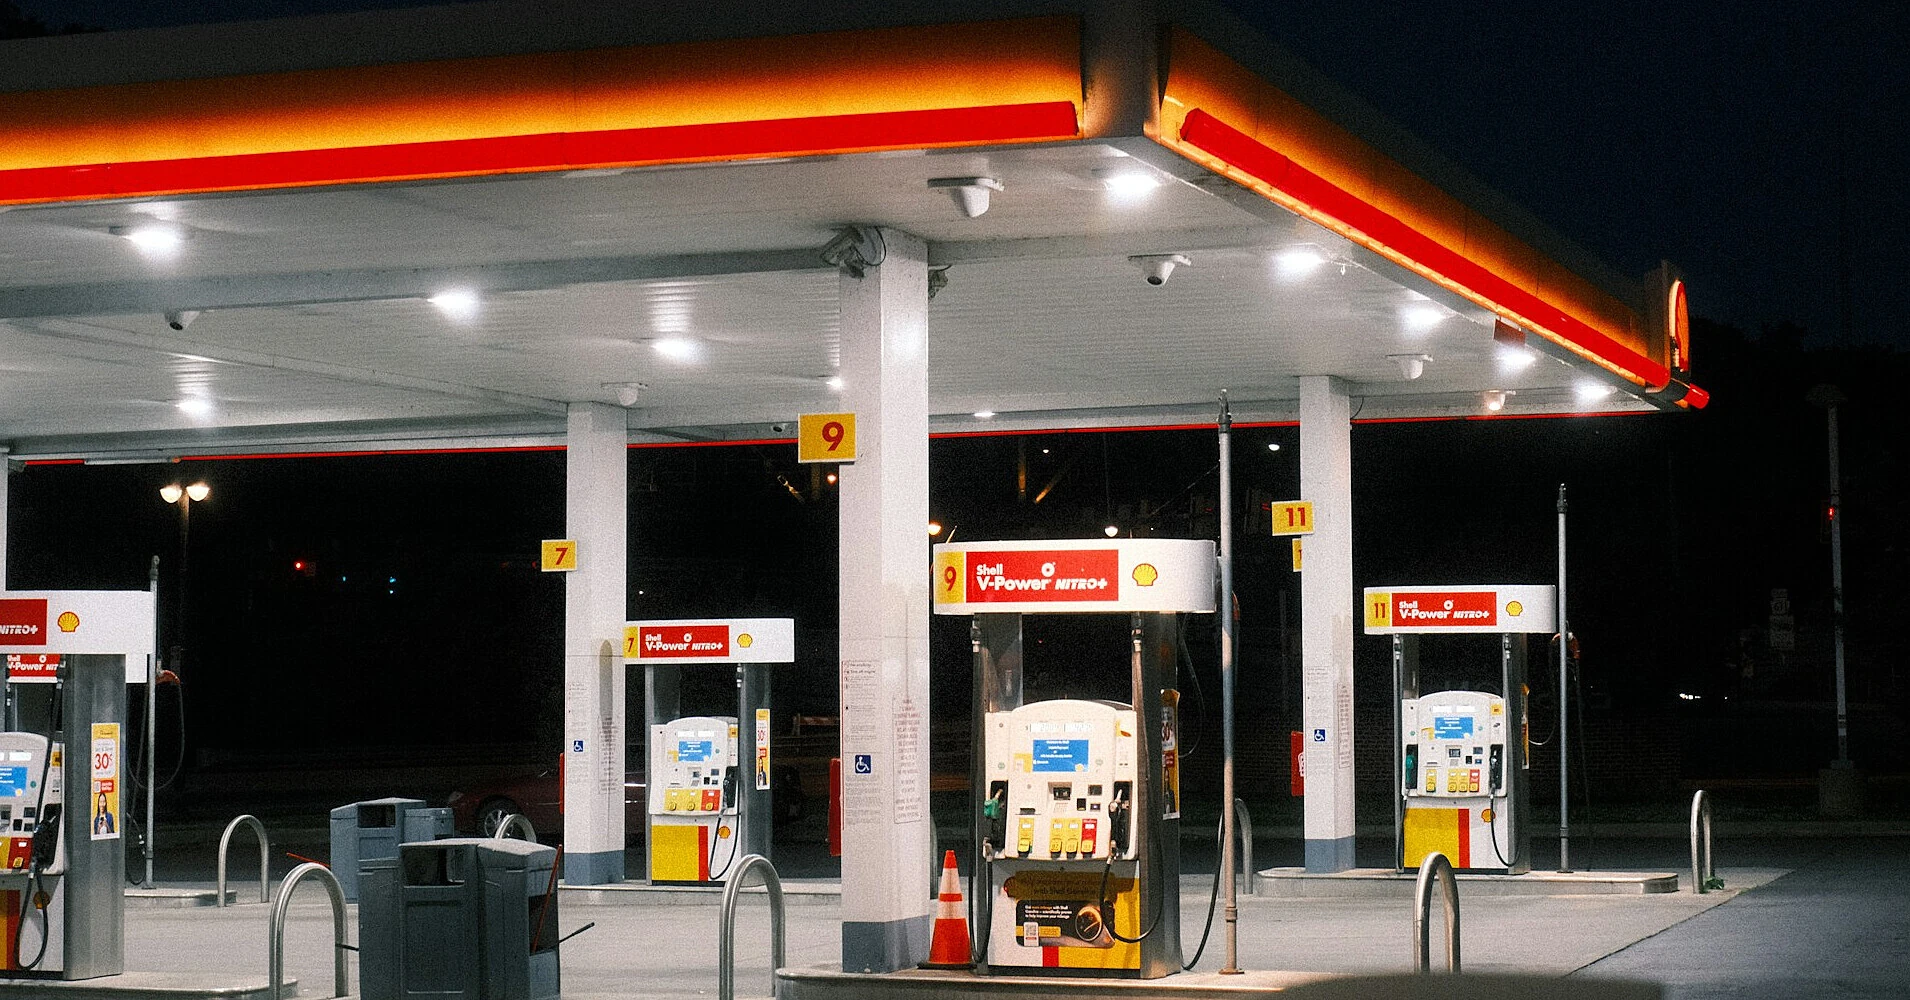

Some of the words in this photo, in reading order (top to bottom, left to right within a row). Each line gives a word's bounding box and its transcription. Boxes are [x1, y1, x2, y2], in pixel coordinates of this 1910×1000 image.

[821, 421, 845, 452] 9
[1285, 507, 1306, 527] 11
[555, 547, 569, 566] 7
[976, 564, 1004, 577] Shell
[944, 566, 957, 592] 9
[976, 576, 1049, 591] V-Power
[1054, 577, 1108, 591] NITRO+
[1374, 602, 1386, 619] 11
[1398, 600, 1418, 609] Shell
[1398, 608, 1449, 620] V-Power
[1452, 610, 1490, 620] NITRO+
[627, 637, 635, 653] 7
[645, 633, 662, 642] Shell
[645, 641, 689, 651] V-Power
[691, 642, 724, 651] NITRO+
[45, 663, 59, 671] NIT
